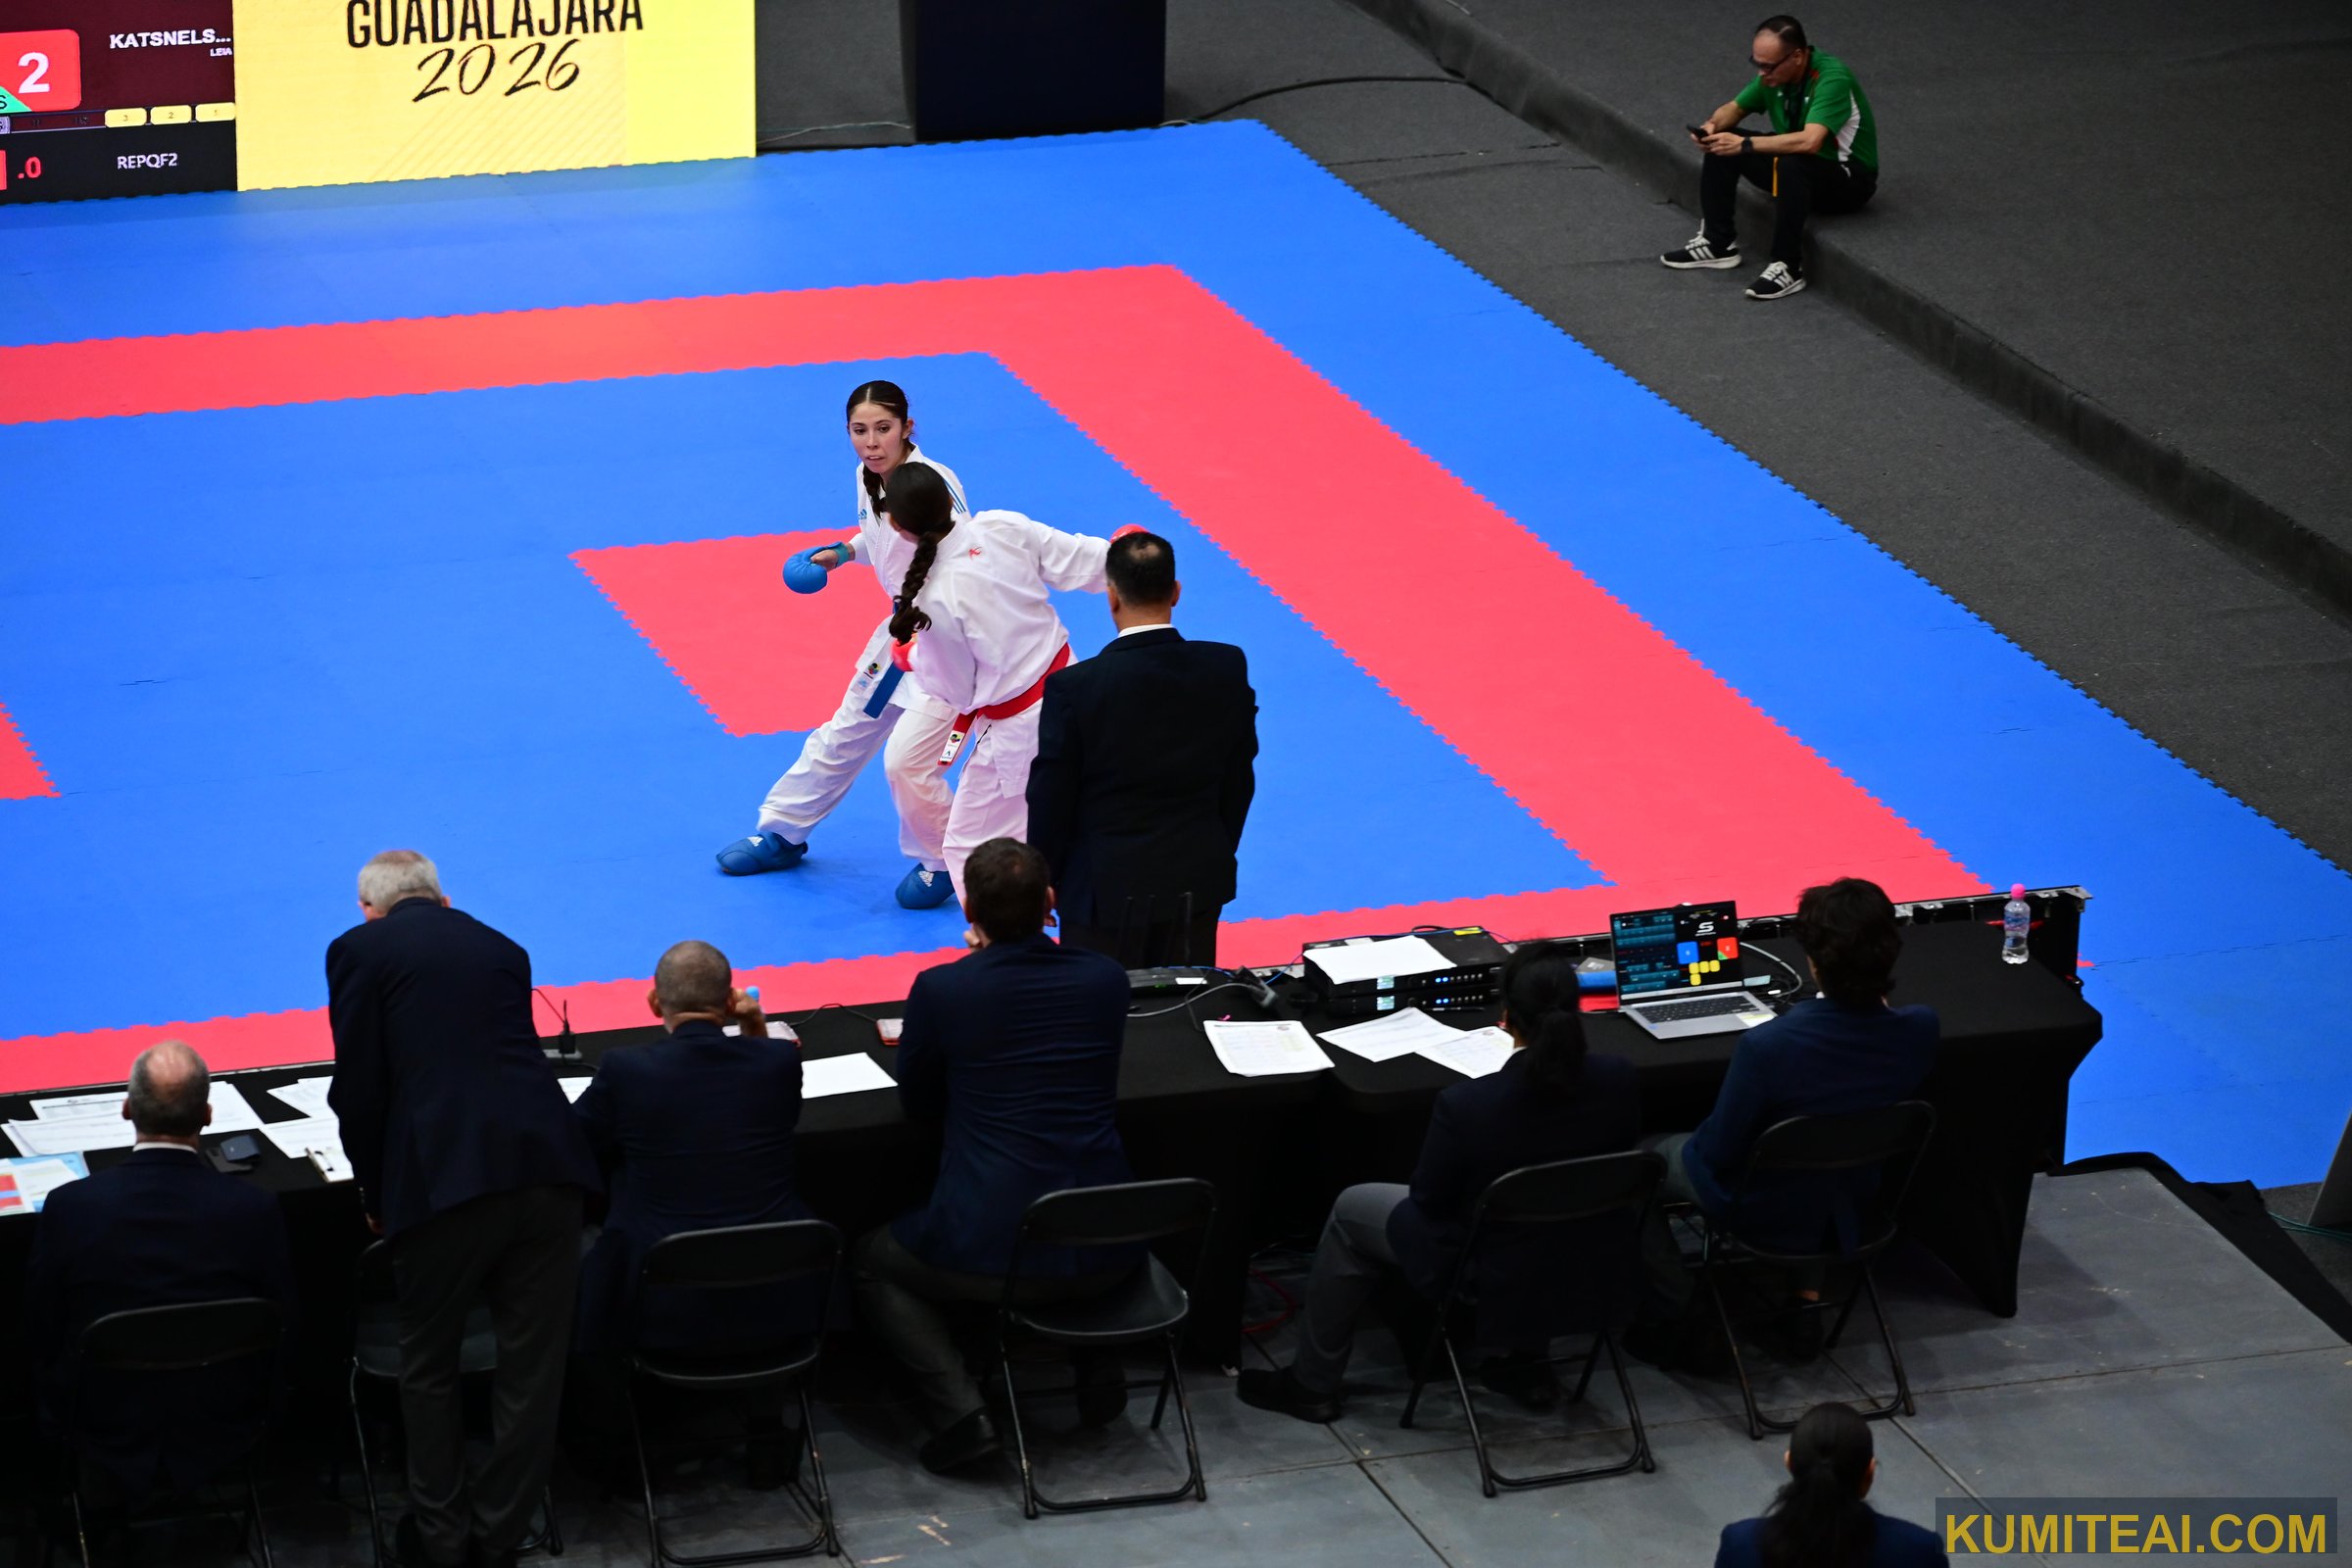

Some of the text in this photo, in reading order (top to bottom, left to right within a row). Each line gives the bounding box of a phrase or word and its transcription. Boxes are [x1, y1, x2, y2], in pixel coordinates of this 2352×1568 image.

[346, 0, 644, 48] GUADALAJARA
[18, 52, 50, 93] 2
[412, 38, 580, 102] 2026
[117, 153, 178, 170] REPQF2
